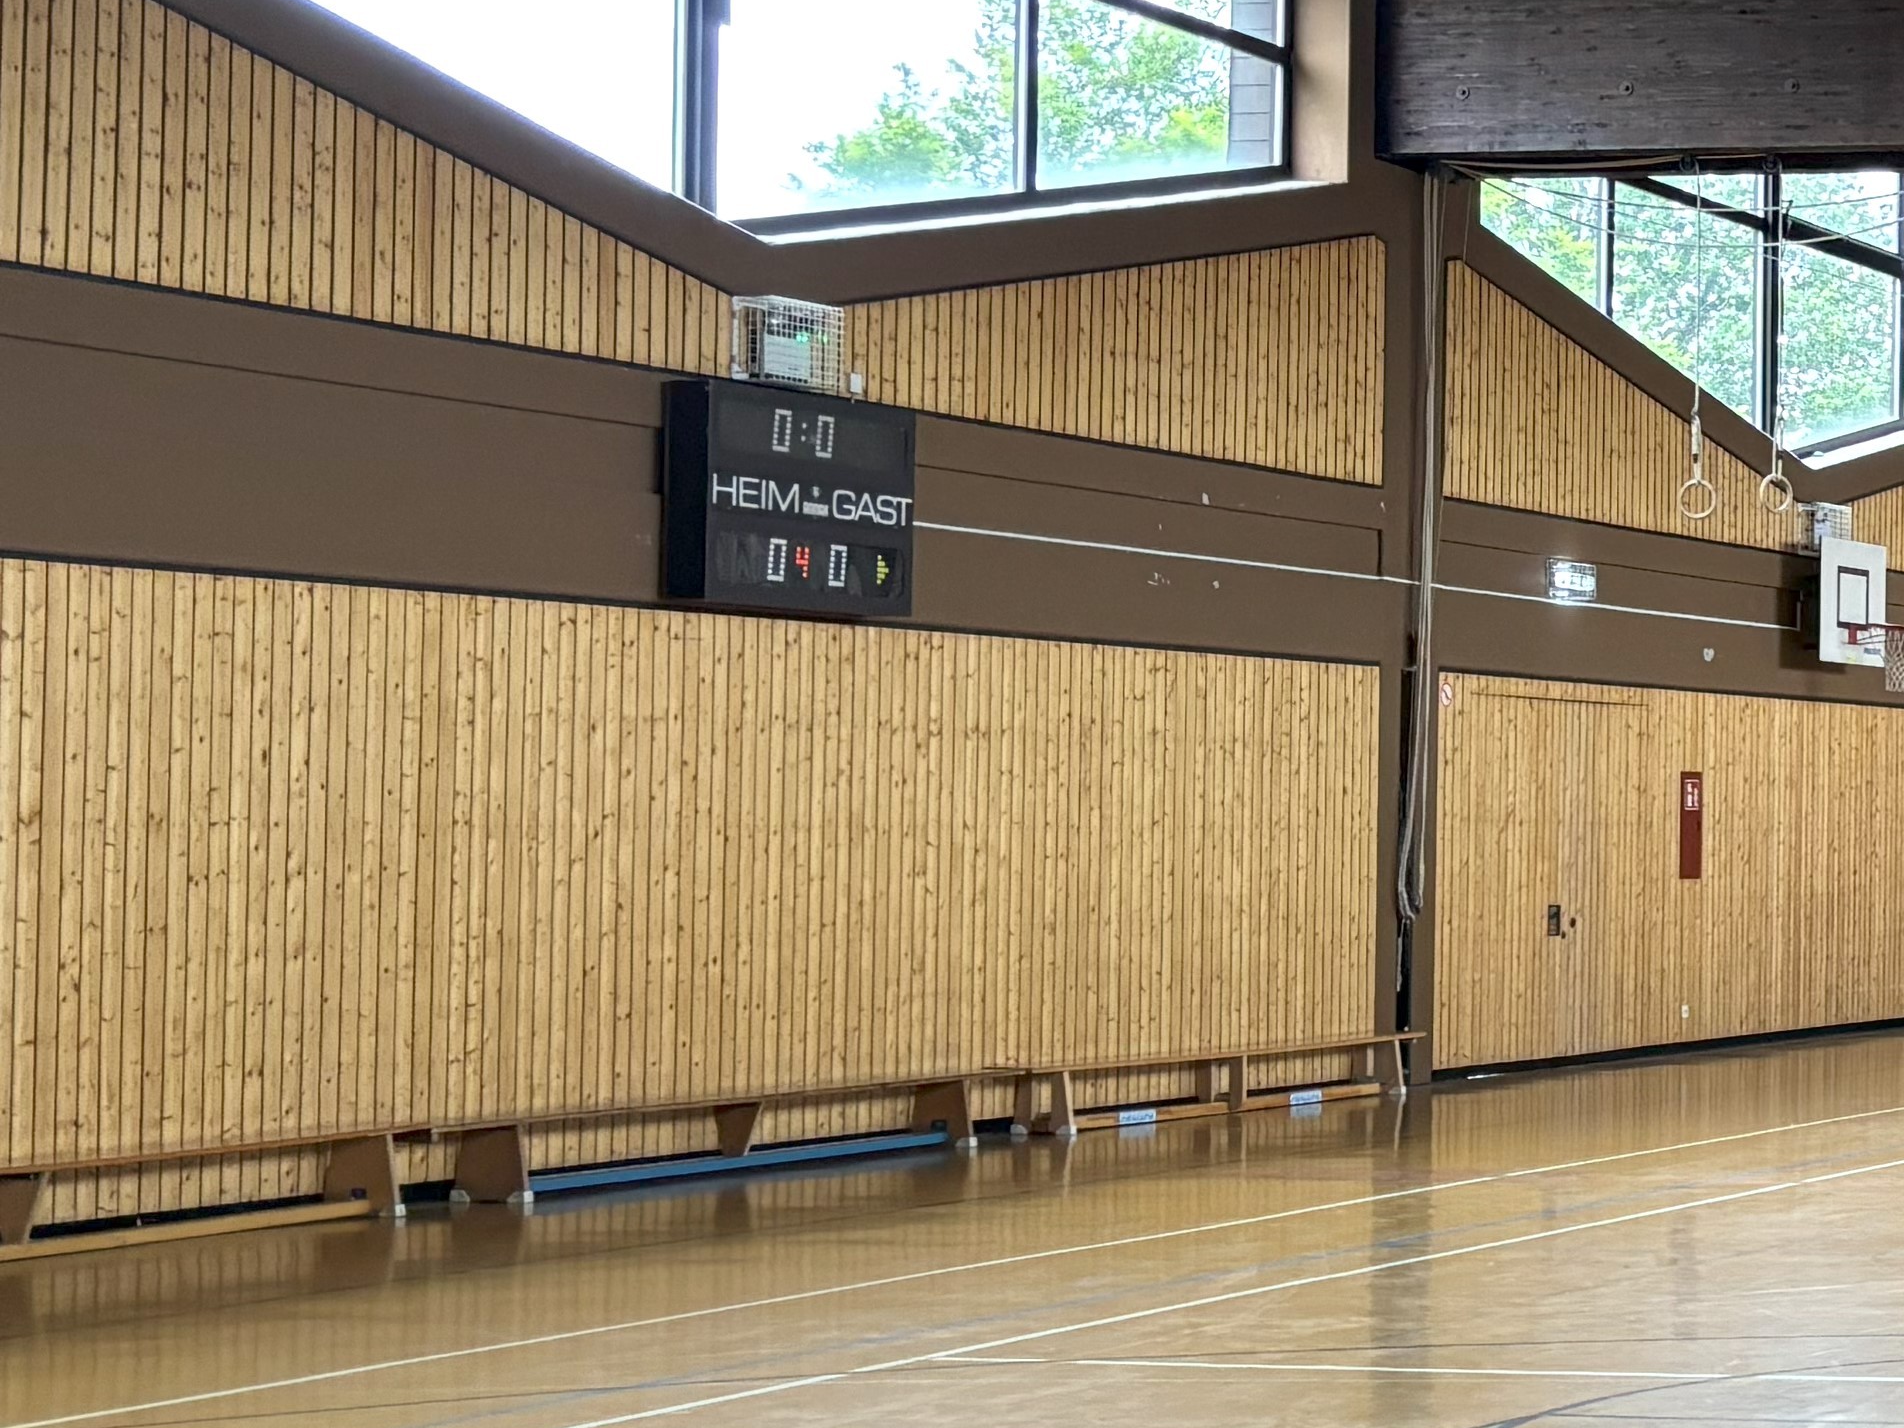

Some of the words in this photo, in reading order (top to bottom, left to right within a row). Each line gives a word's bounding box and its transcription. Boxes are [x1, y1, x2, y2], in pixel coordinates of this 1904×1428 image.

[712, 473, 800, 514] HEIM
[832, 490, 913, 526] GAST
[795, 546, 810, 579] 4
